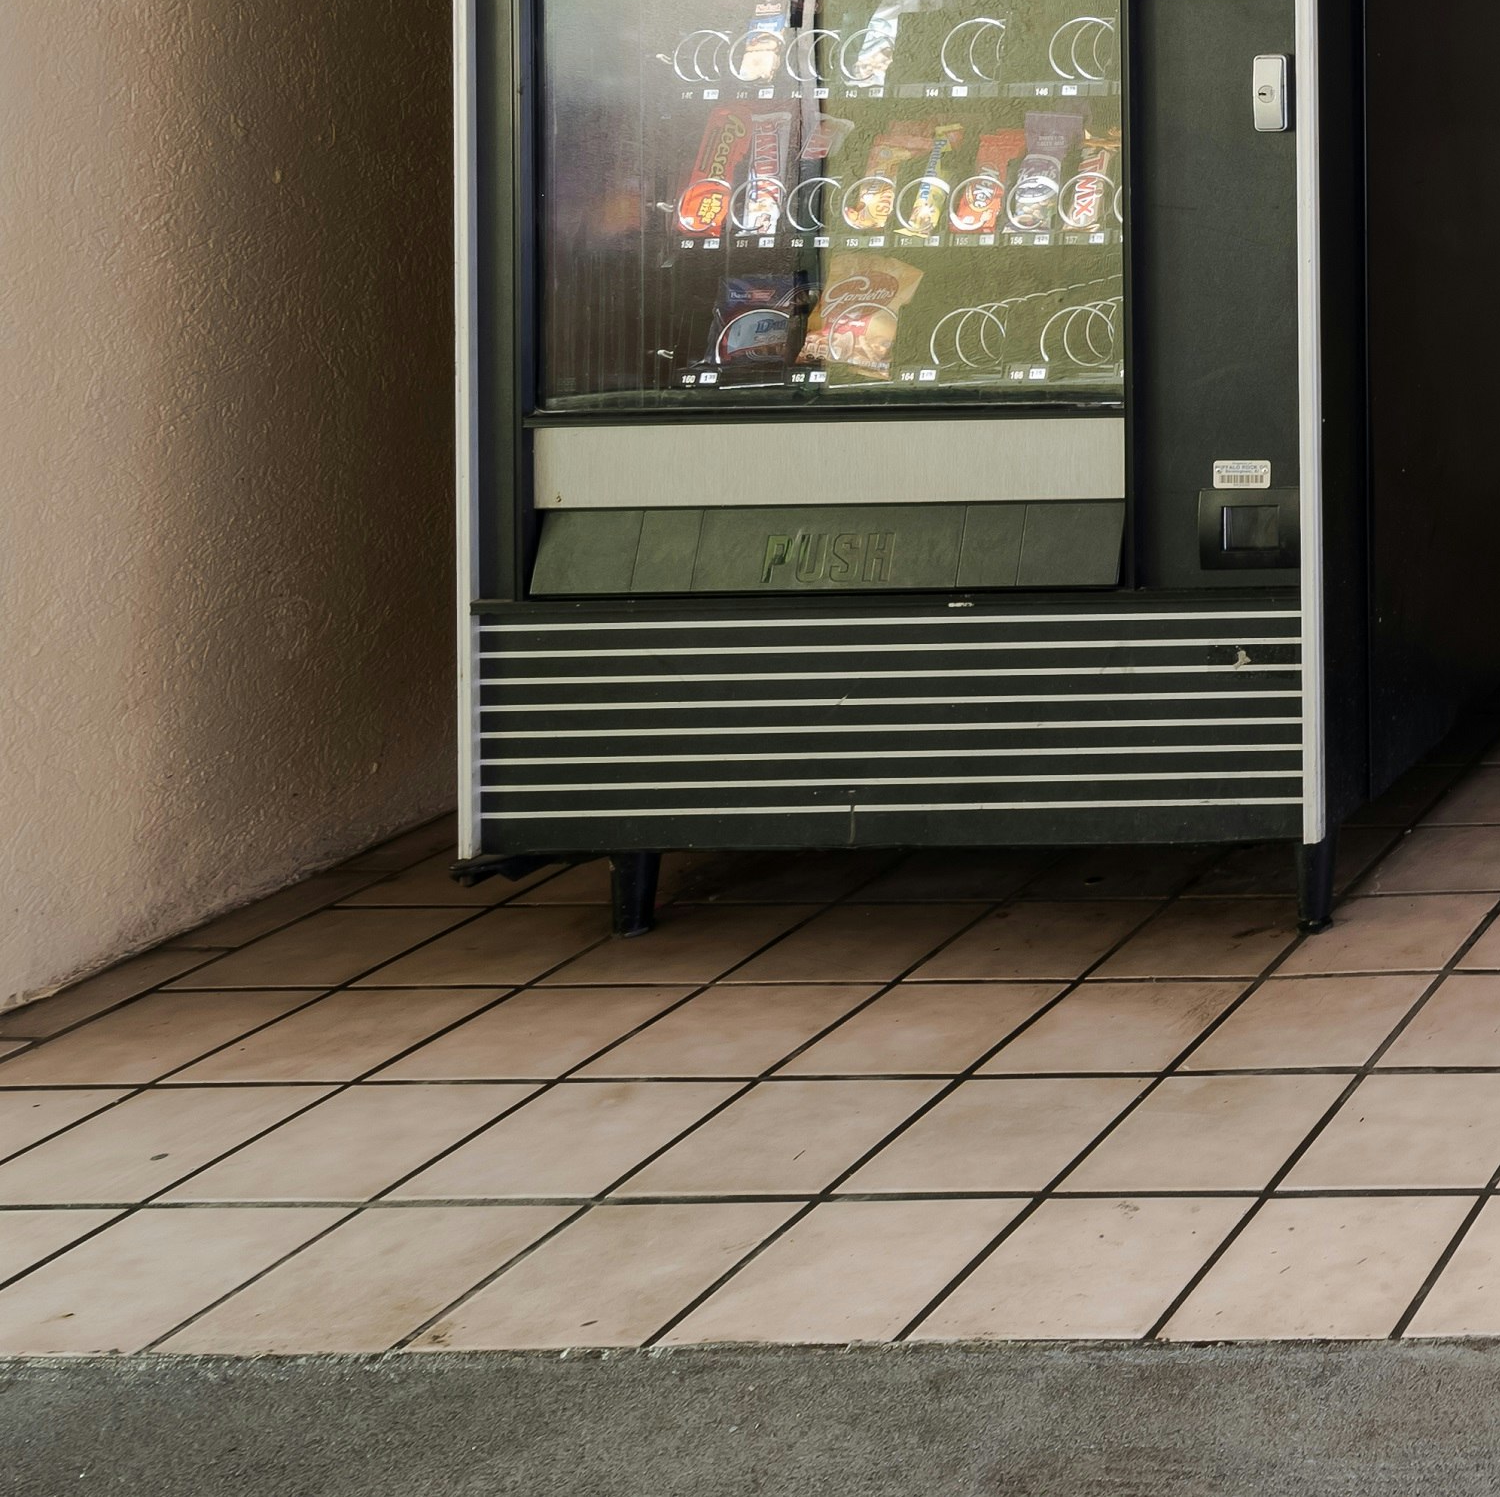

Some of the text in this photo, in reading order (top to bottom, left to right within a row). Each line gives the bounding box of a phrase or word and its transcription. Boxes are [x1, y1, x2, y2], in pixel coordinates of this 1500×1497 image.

[681, 240, 694, 248] 150
[736, 240, 748, 248] 151
[791, 239, 803, 247] 152
[760, 532, 896, 583] PUSH
